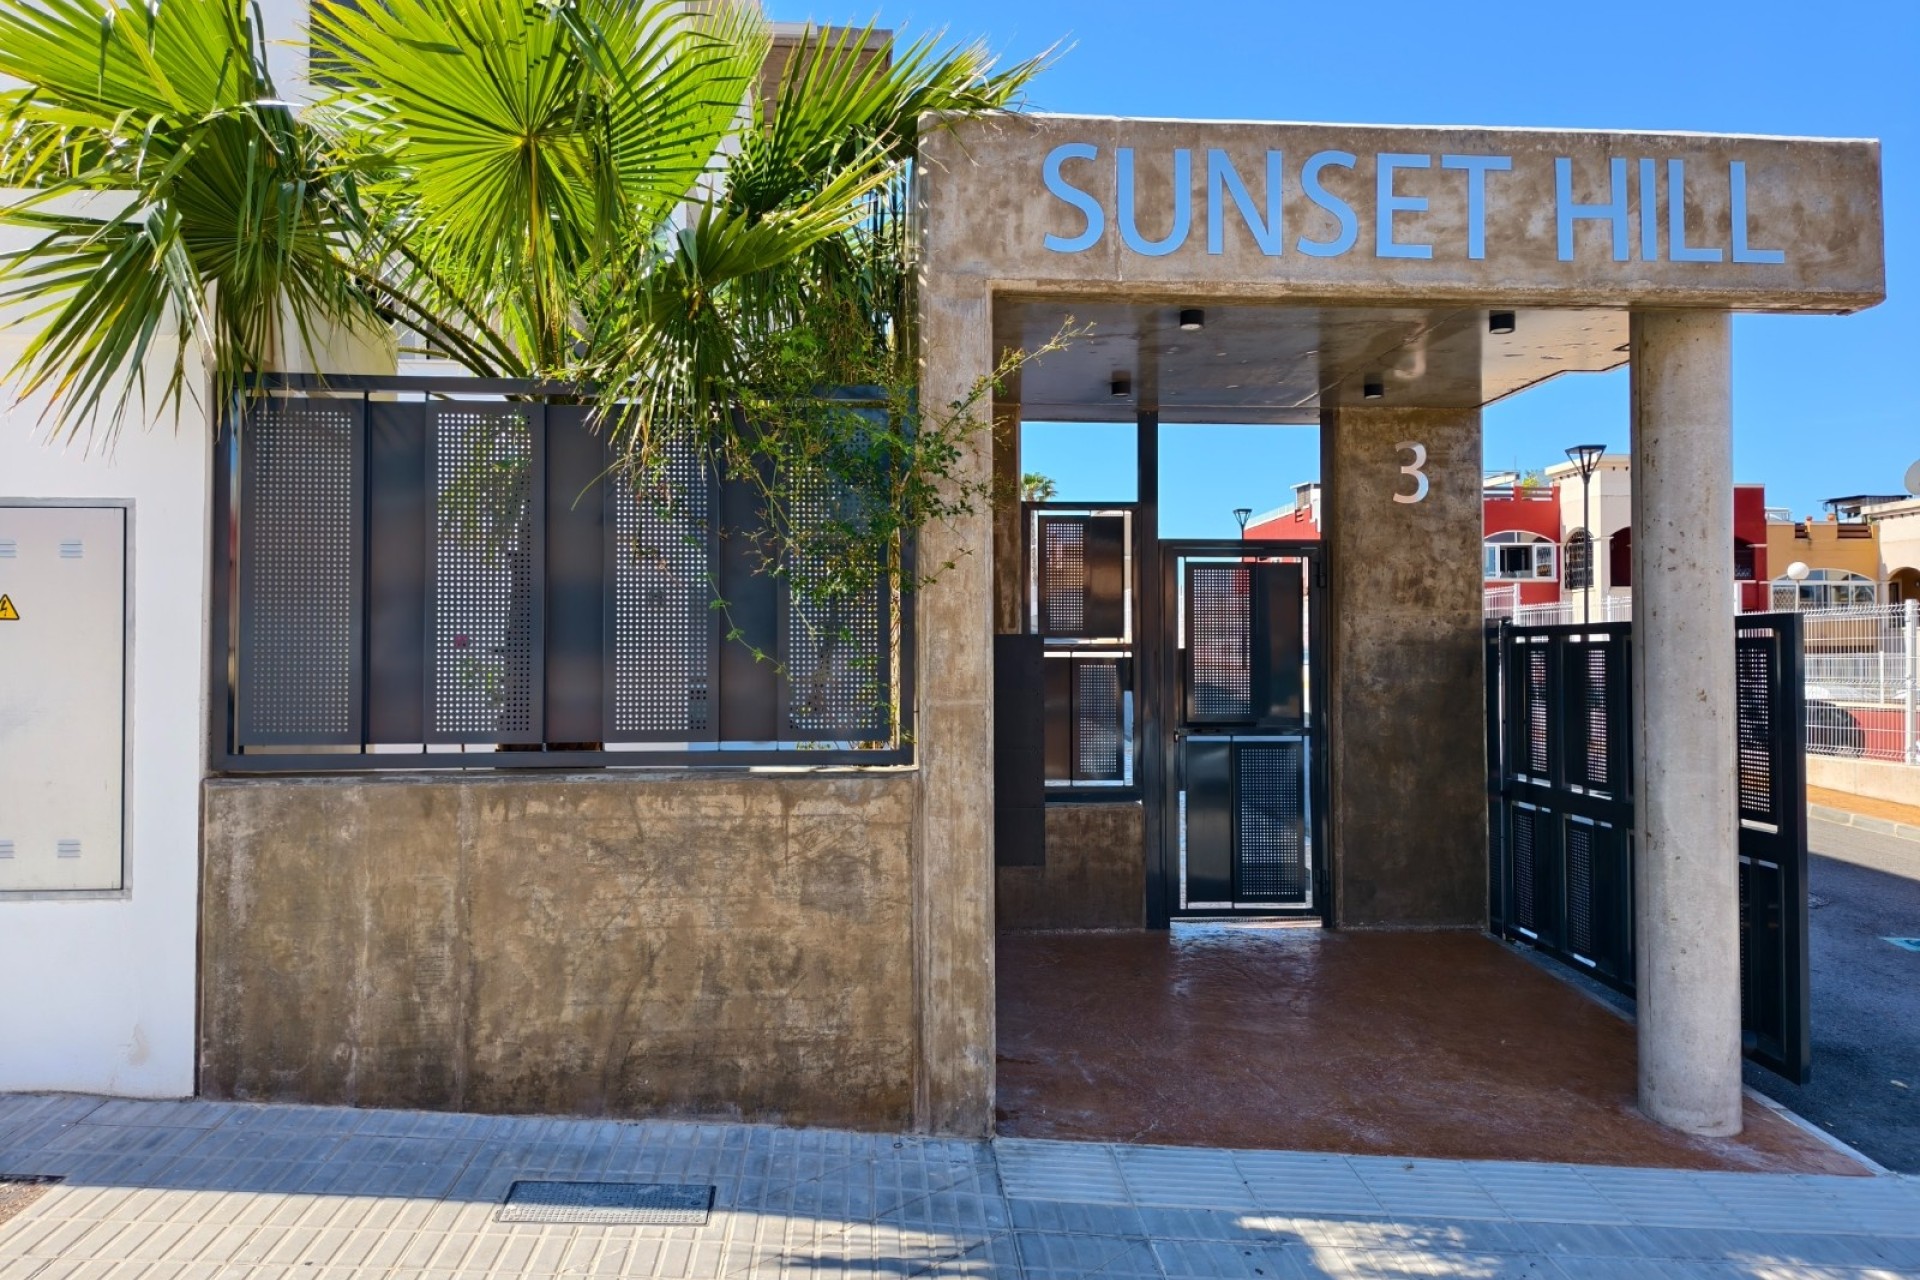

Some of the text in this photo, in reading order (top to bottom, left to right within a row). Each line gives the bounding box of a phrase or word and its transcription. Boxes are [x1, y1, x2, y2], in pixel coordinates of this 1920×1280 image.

[1042, 142, 1785, 264] SUNSET HILL
[1393, 441, 1429, 504] 3
